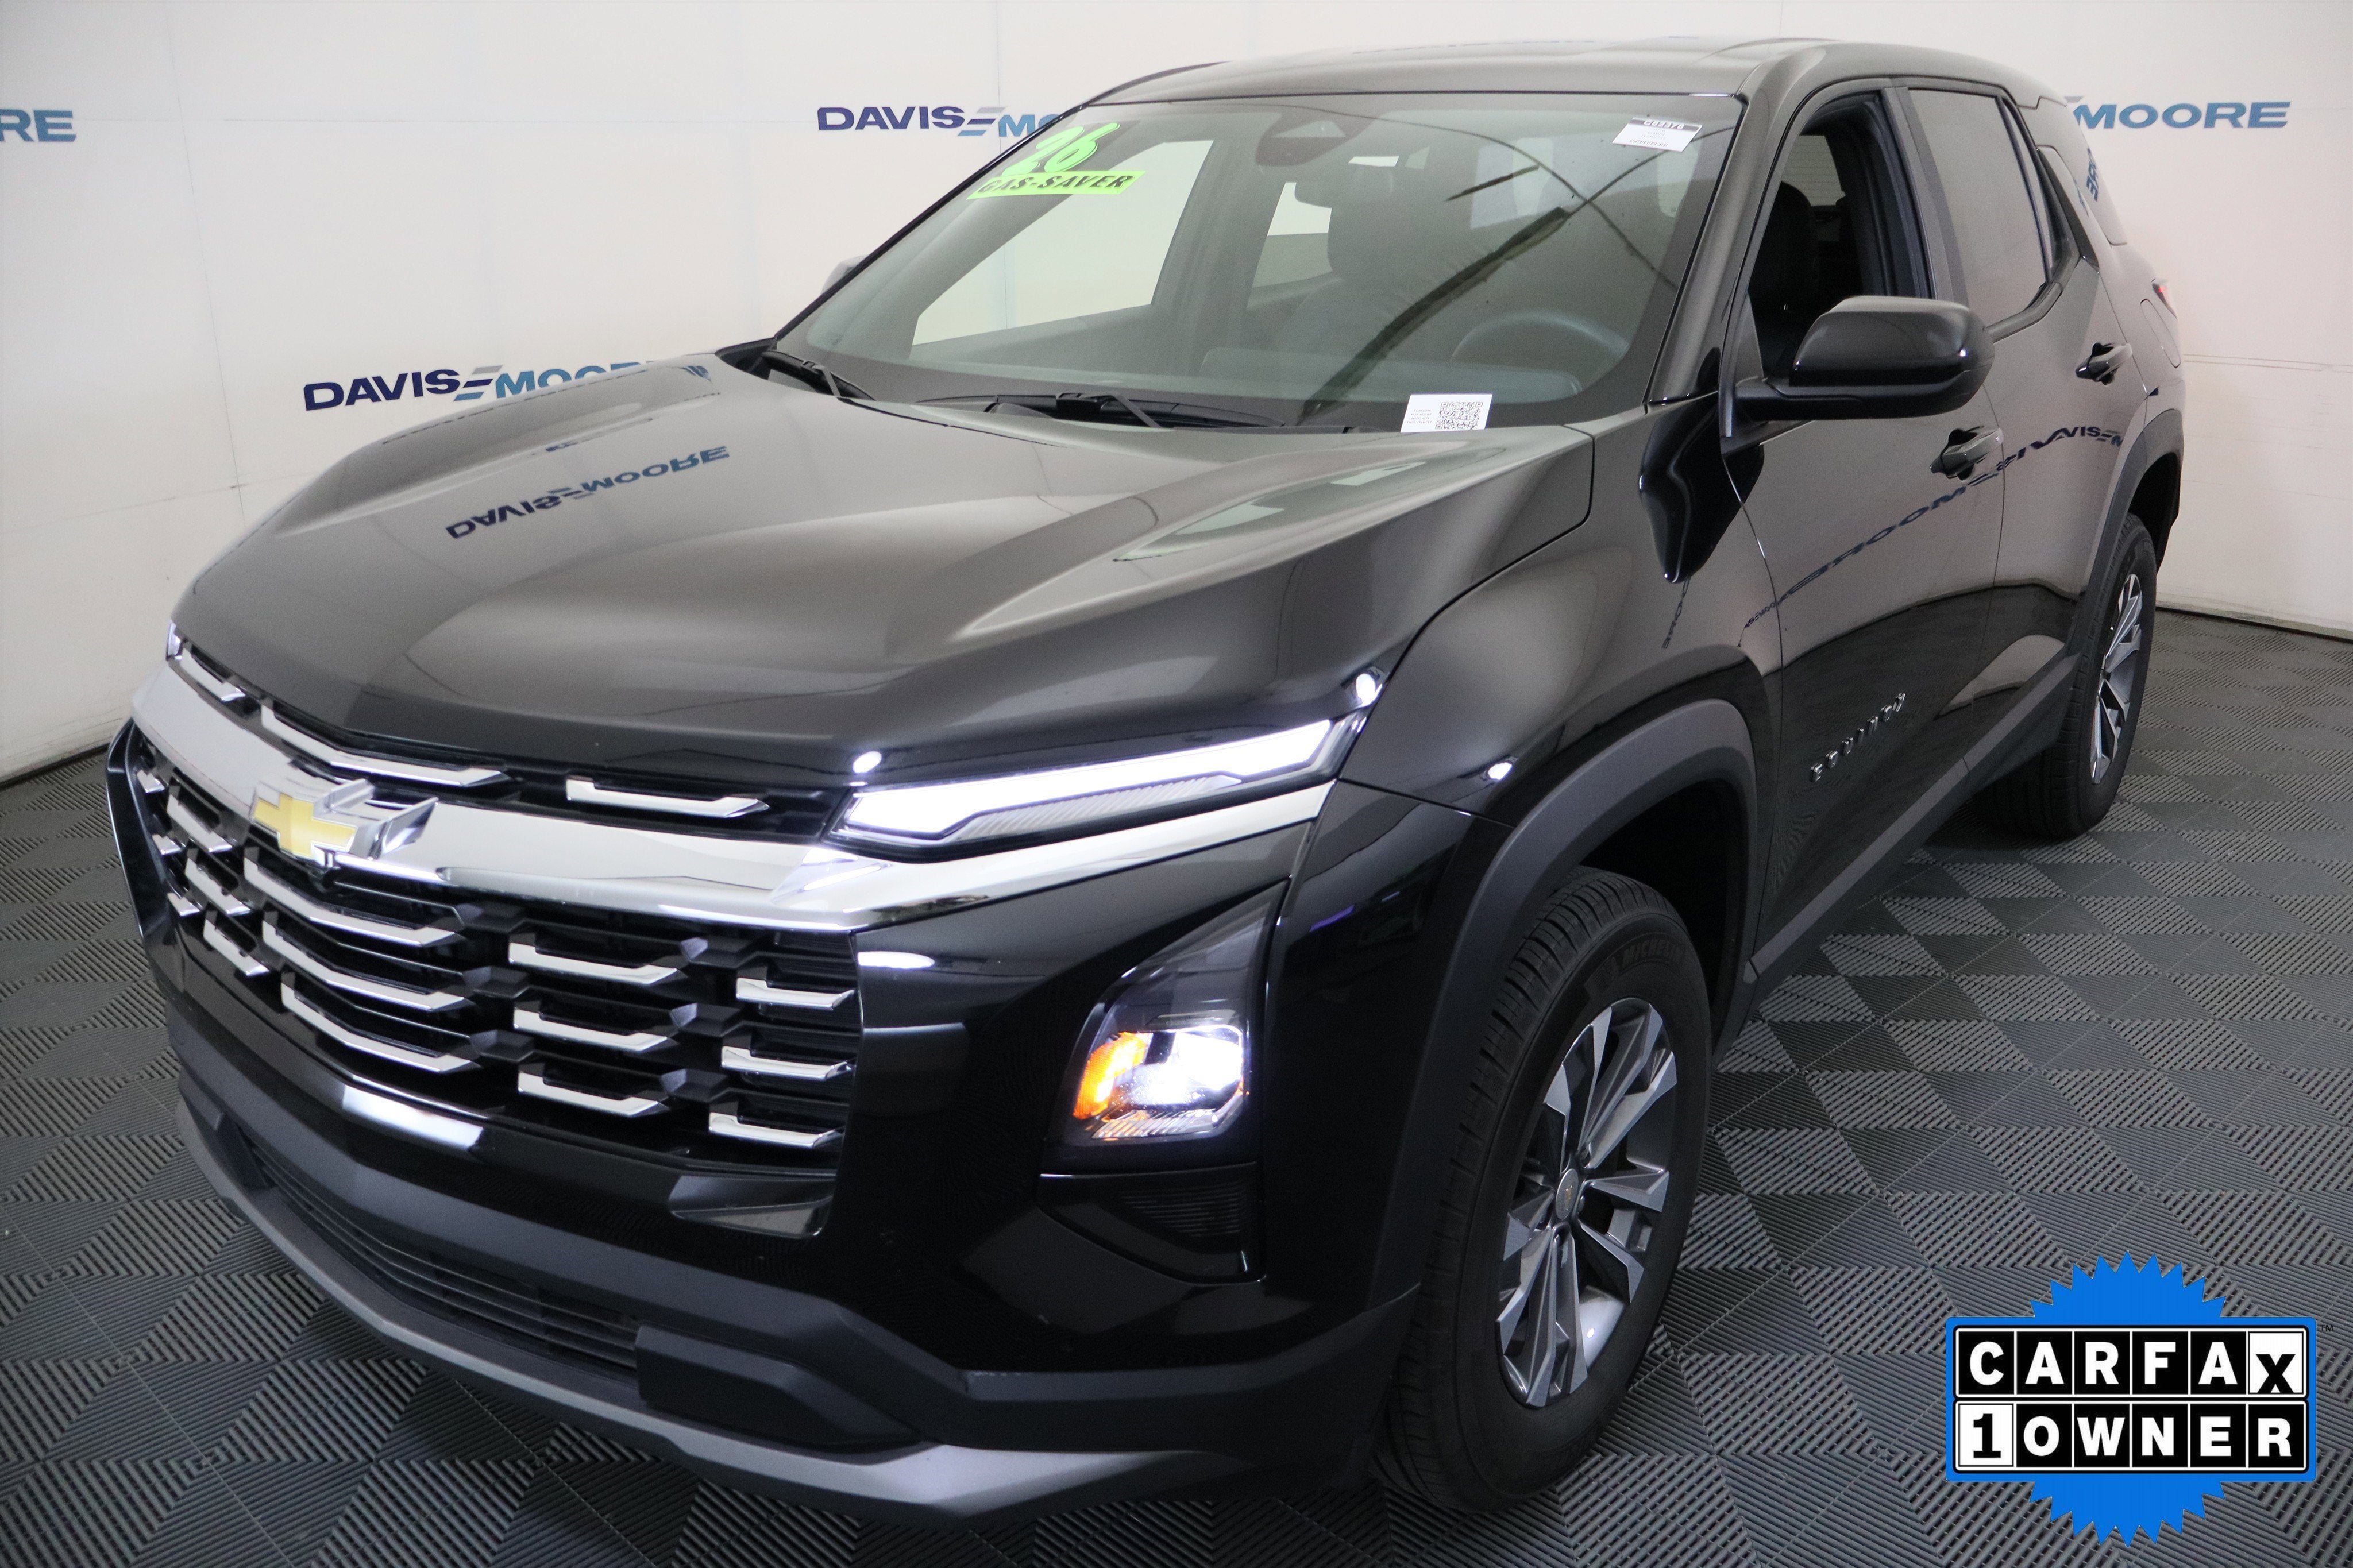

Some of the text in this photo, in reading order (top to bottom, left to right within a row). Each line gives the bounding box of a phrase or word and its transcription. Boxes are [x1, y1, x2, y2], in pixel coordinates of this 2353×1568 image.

[817, 106, 963, 130] DAVIS
[2073, 102, 2290, 129] MOORE
[977, 175, 1135, 194] GAS-SAVER
[303, 369, 461, 412] DAVIS
